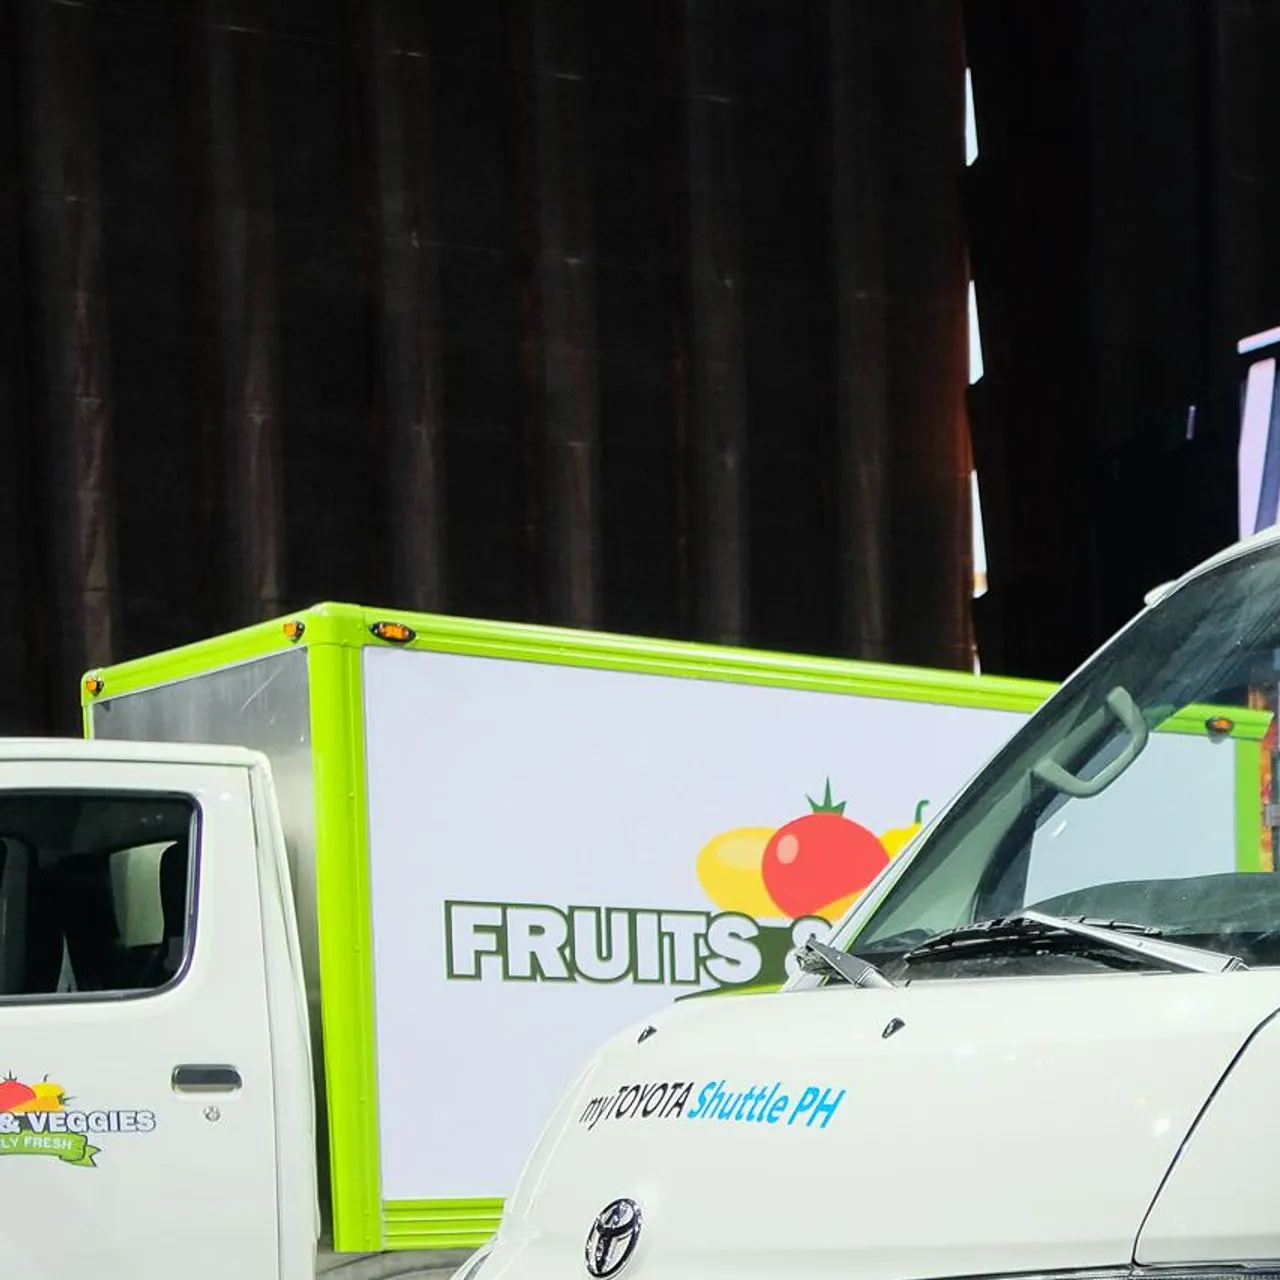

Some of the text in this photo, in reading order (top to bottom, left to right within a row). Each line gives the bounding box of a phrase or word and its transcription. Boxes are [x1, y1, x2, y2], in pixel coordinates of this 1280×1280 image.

[445, 900, 763, 986] FRUITS
[26, 1110, 156, 1134] VEGGIES
[578, 1080, 847, 1132] myTOYOTA Shuttle PH
[24, 1136, 73, 1150] FRESH
